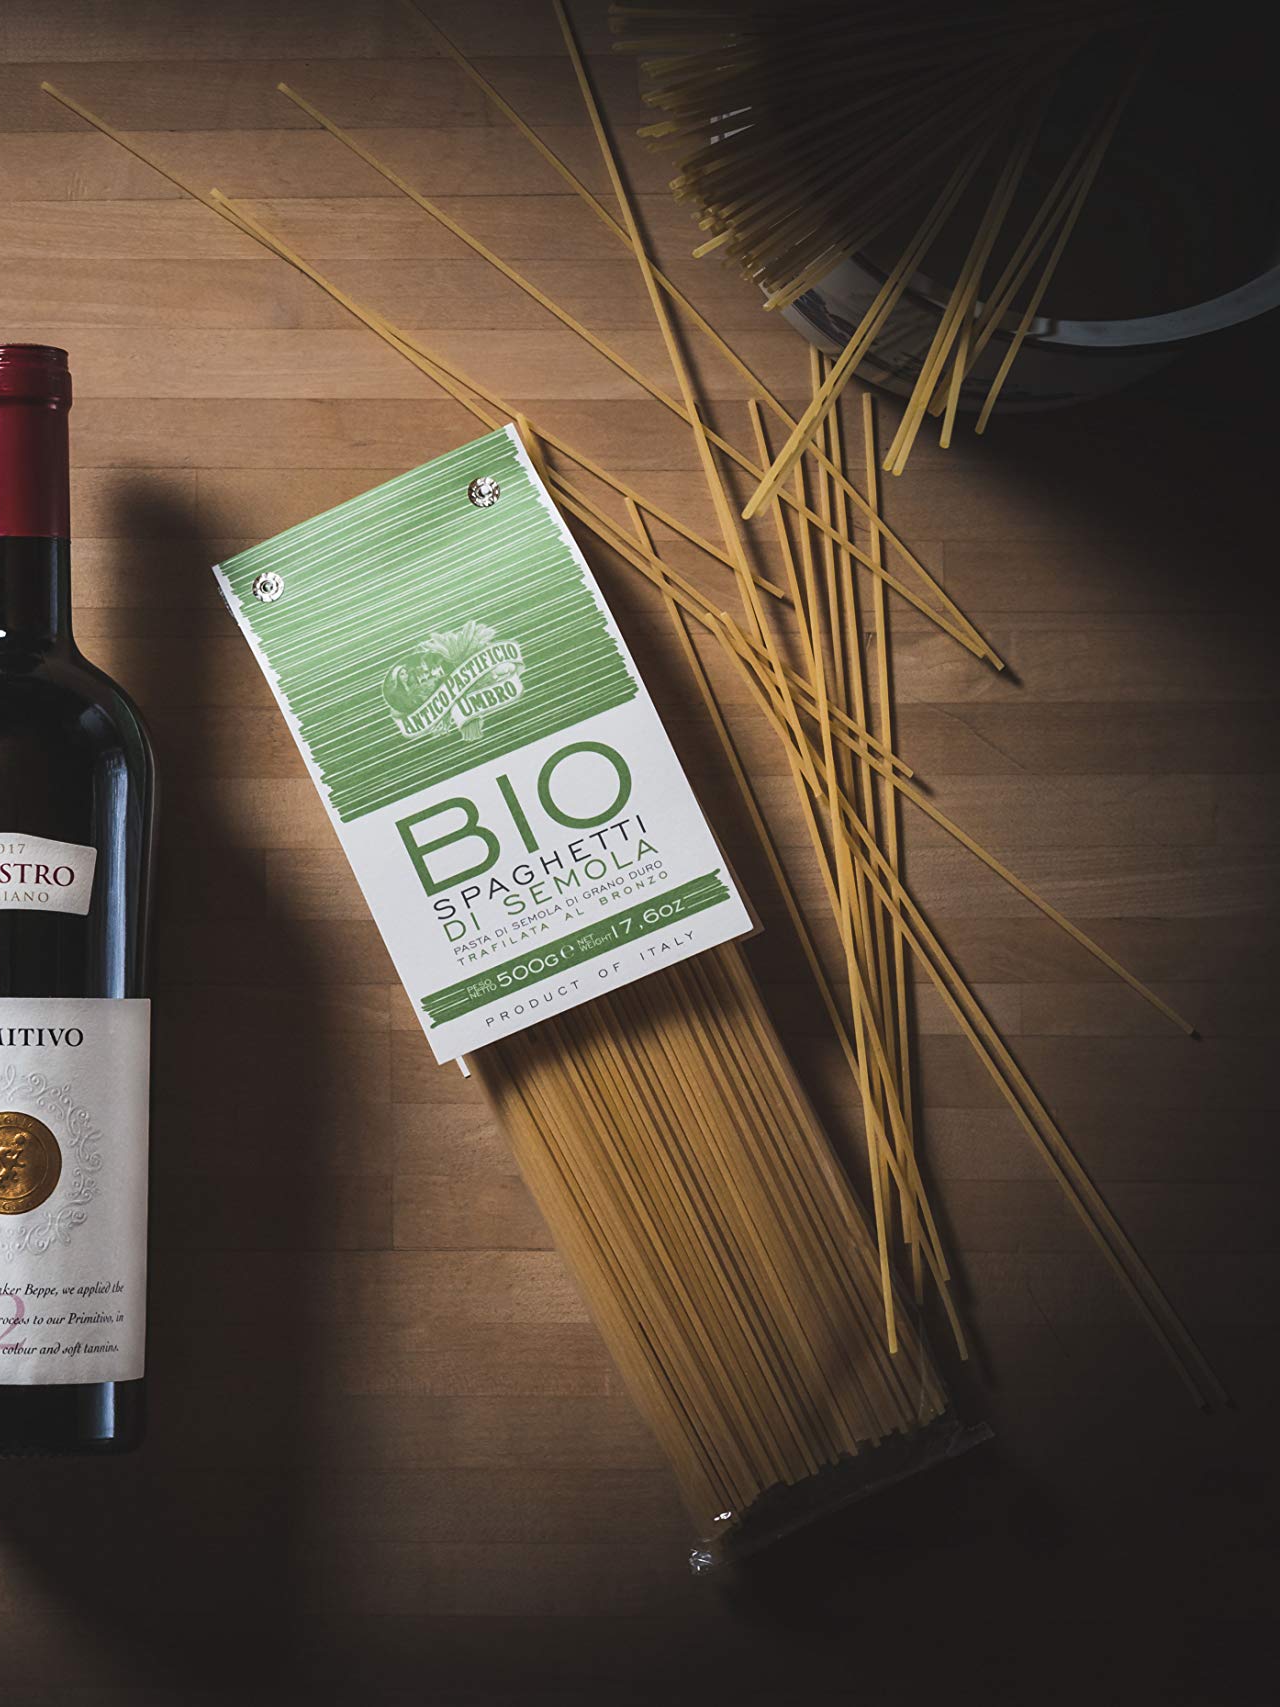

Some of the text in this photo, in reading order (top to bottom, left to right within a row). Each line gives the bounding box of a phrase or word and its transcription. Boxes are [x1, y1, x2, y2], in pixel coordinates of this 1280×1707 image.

[400, 643, 518, 734] ANTICO PASTIFICIO
[456, 681, 518, 717] UMBRO
[395, 741, 632, 897] BIO
[433, 814, 647, 920] SPAGHETTI
[443, 839, 659, 942] DI SEMOLA
[454, 859, 663, 956] PASTA DI SEMOLA DI GRANO DURO
[457, 870, 668, 966] TRAFILATA AL BRONZO
[466, 978, 493, 993] PESO
[577, 933, 595, 945] NET
[469, 932, 613, 1000] NETTO WEIGHT
[485, 930, 696, 1027] PRODUCT OF ITALY
[24, 1283, 59, 1298] Beppe,
[62, 1286, 75, 1295] we
[77, 1281, 111, 1297] applied
[111, 1280, 124, 1293] the
[33, 1313, 44, 1325] to
[46, 1316, 64, 1325] our
[67, 1312, 114, 1325] Primitivo,
[115, 1310, 124, 1323] in
[2, 1342, 35, 1355] colour
[39, 1342, 61, 1355] and
[62, 1341, 81, 1357] soft
[84, 1340, 120, 1353] tannins.
